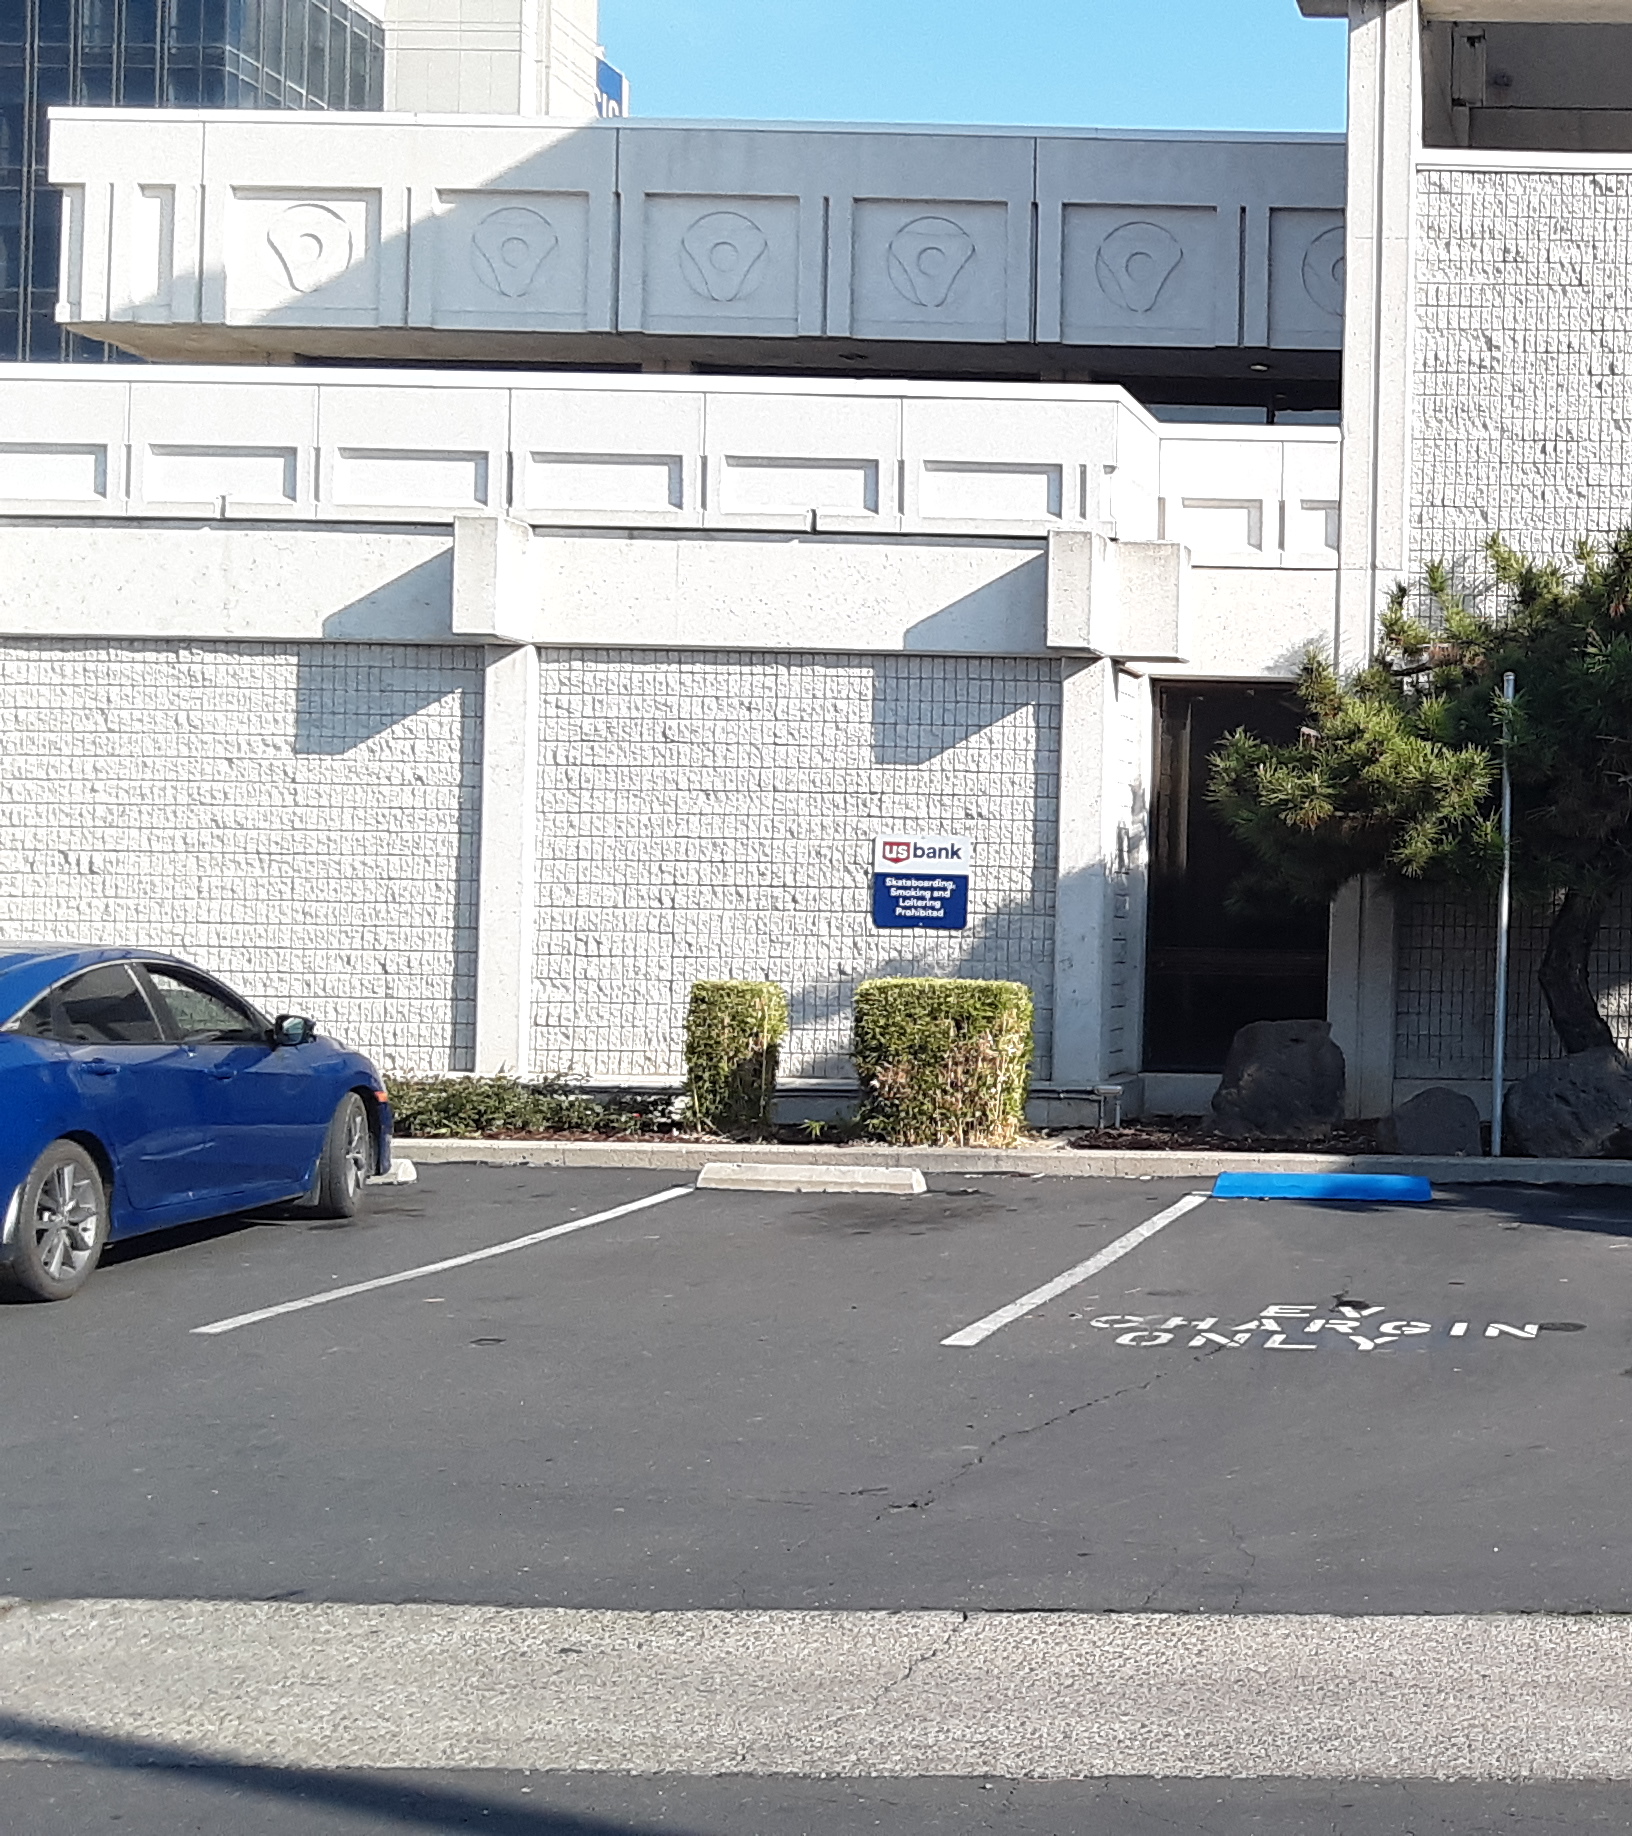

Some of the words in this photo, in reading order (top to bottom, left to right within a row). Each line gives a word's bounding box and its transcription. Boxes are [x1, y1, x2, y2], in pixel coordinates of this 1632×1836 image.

[913, 842, 962, 859] bank
[885, 877, 956, 890] Skateboarding,
[890, 887, 931, 899] Smoking
[933, 888, 951, 898] and
[899, 898, 941, 909] Loitering
[895, 907, 944, 917] Prohibited
[1259, 1304, 1386, 1318] EV
[1115, 1331, 1399, 1351] ONLY
